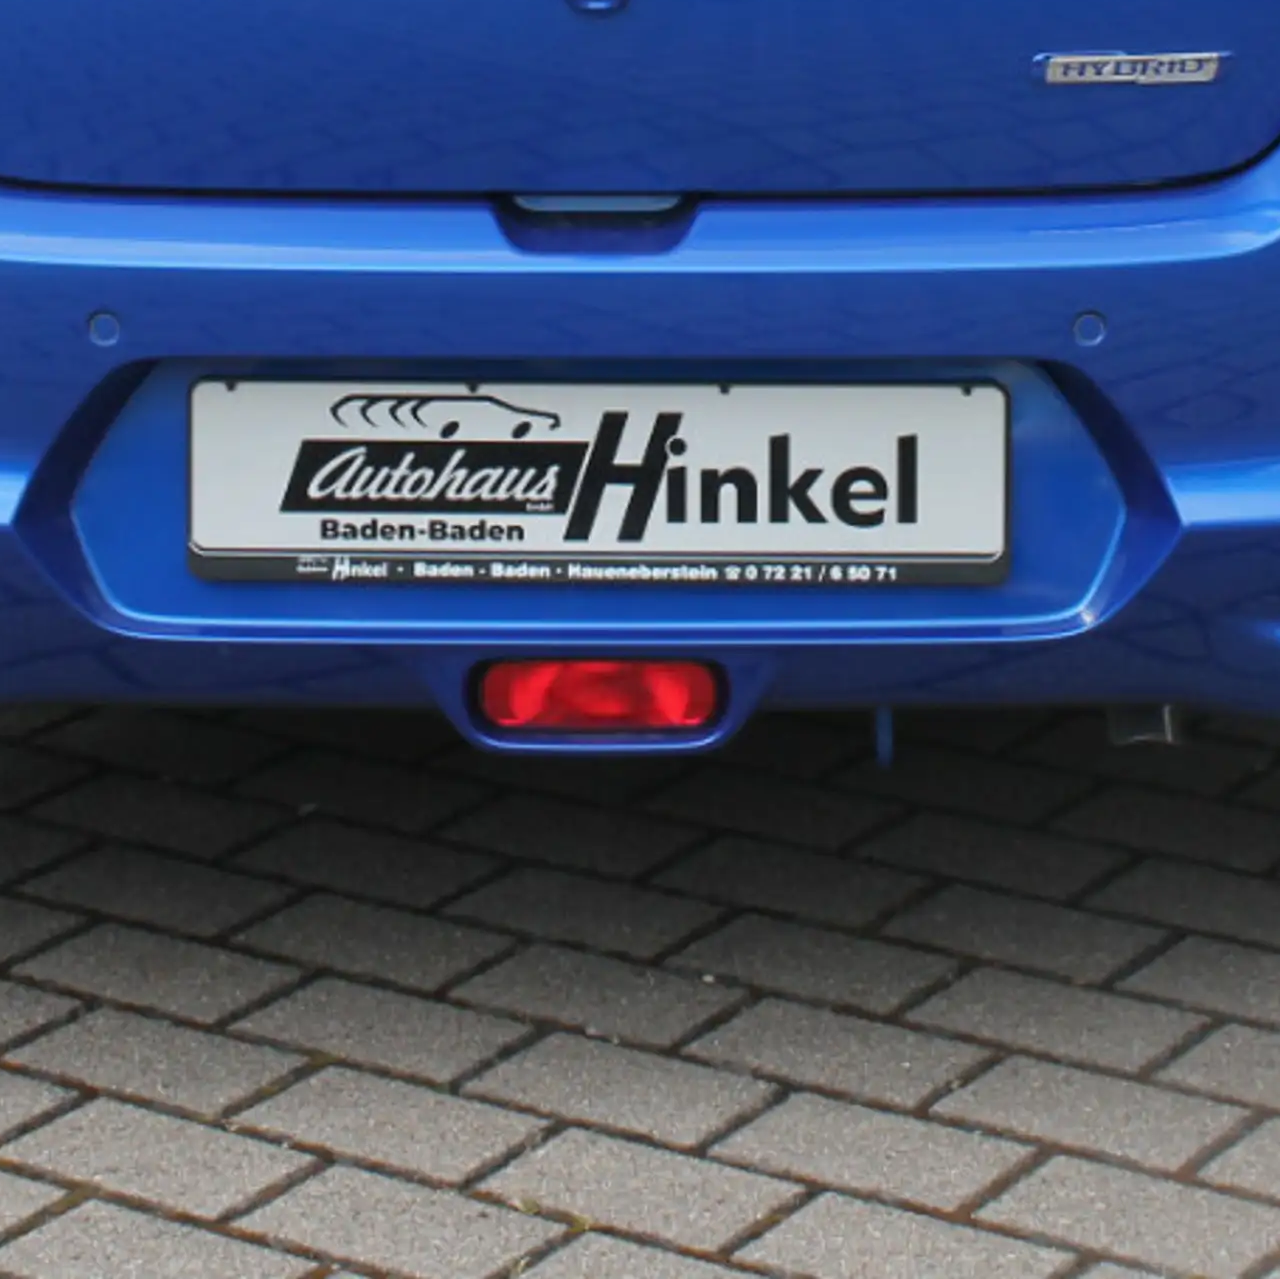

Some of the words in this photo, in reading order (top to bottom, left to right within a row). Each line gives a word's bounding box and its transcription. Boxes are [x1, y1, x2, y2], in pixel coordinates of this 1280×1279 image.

[307, 445, 561, 502] Autohaus
[563, 411, 918, 542] Hinkel
[320, 518, 524, 541] Baden-Baden
[332, 556, 388, 581] Hinkel
[413, 562, 474, 578] Baden
[490, 562, 550, 578] Baden
